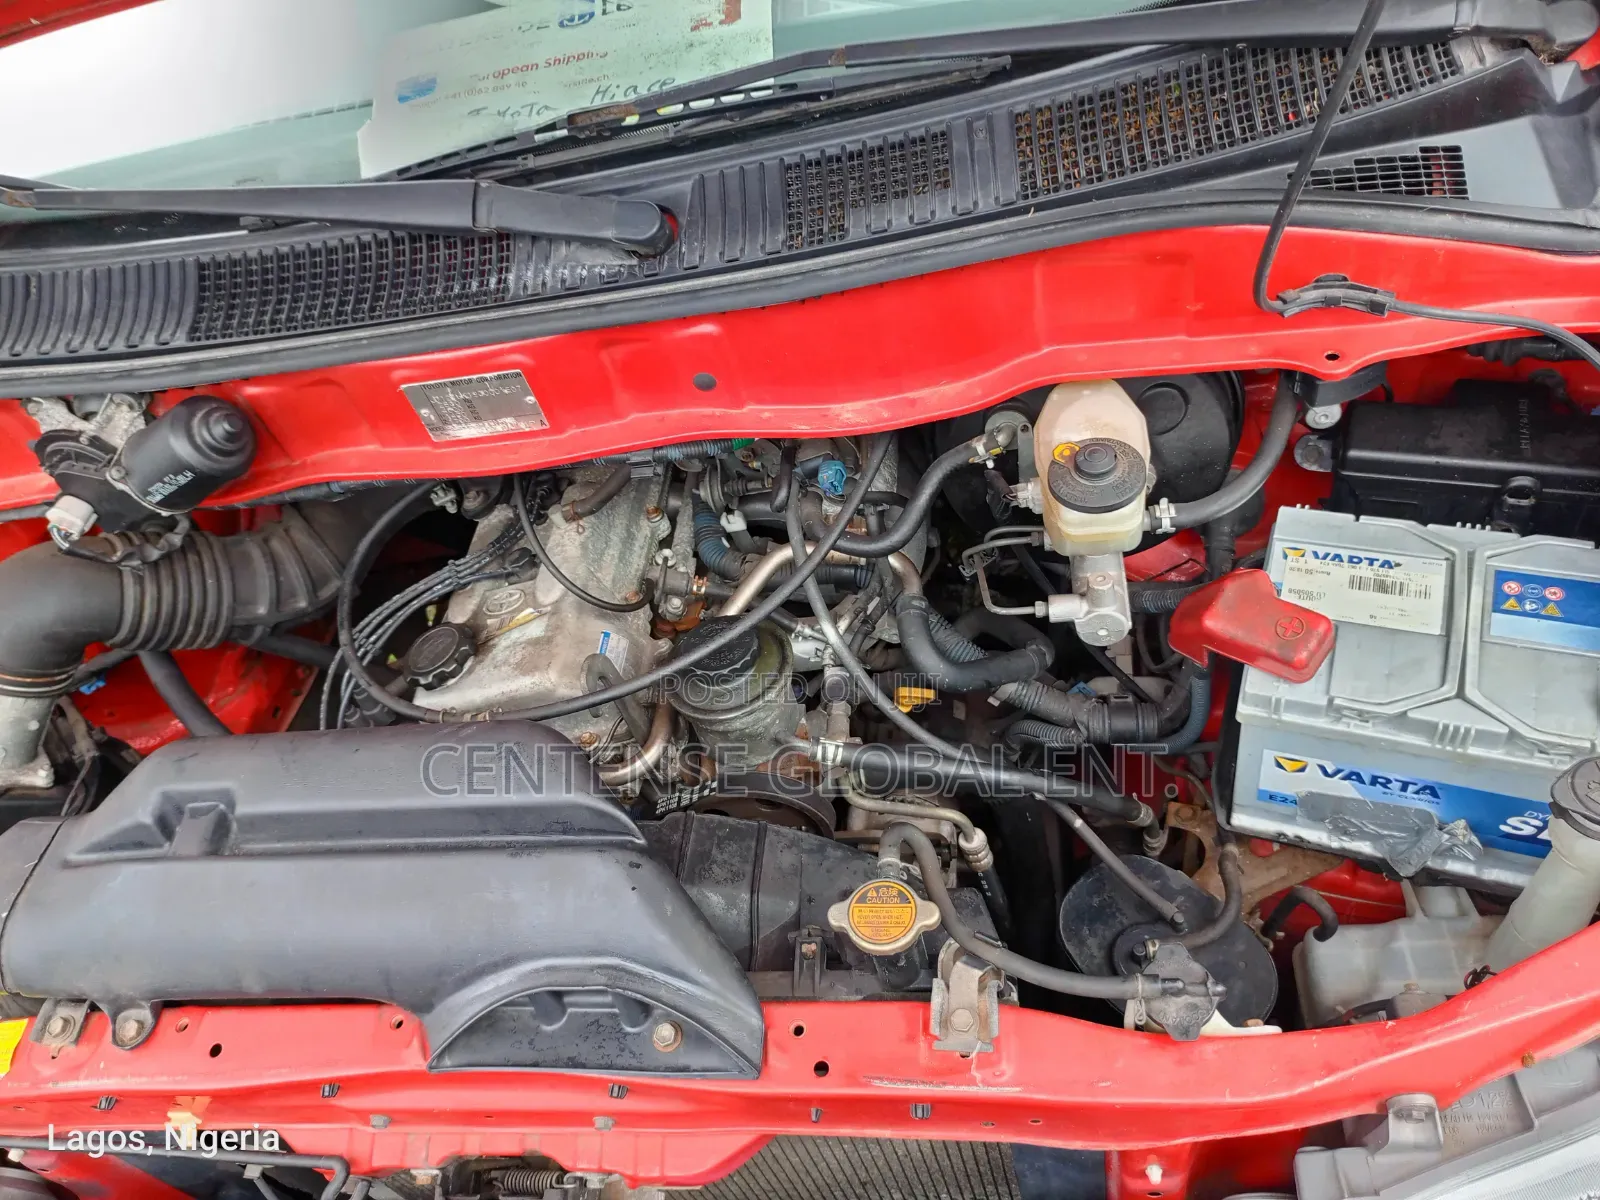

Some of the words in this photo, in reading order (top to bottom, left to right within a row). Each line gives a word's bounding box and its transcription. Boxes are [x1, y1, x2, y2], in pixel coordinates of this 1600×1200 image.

[422, 382, 449, 390] TOYOTA
[451, 378, 473, 387] MOTOR
[476, 371, 523, 384] CORPORATION
[539, 419, 548, 427] A
[1316, 763, 1442, 800] VARTA
[1524, 810, 1550, 821] DY
[866, 896, 901, 904] CAUTION
